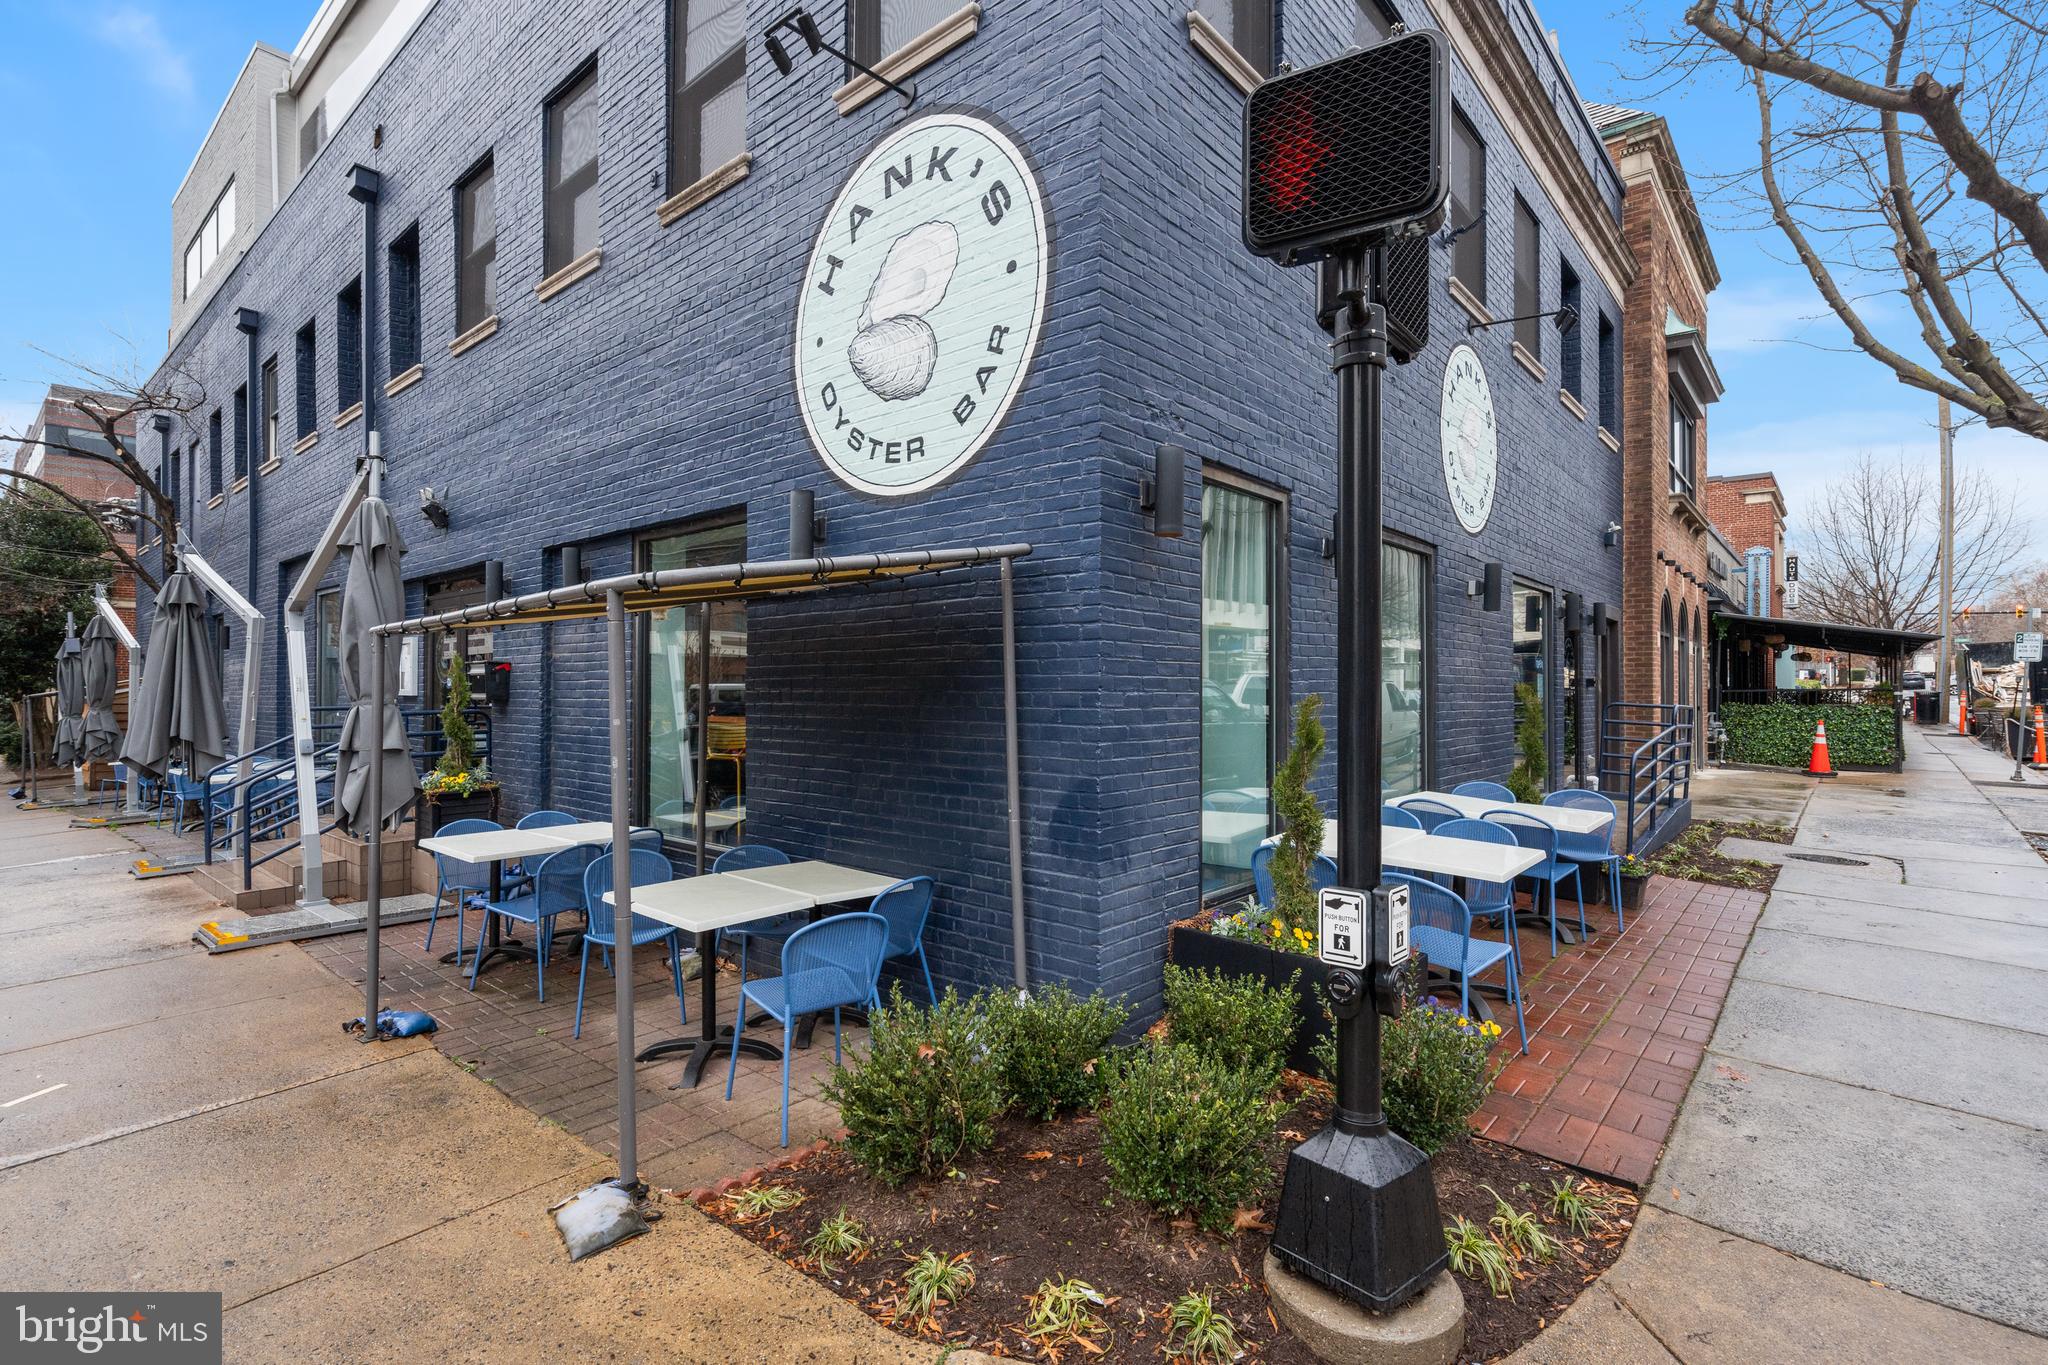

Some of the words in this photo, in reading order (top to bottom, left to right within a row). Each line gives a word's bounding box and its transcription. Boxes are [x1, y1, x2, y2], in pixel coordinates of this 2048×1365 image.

[817, 146, 1012, 296] HANK'S
[821, 382, 925, 464] OYSTER
[952, 324, 1010, 427] BAR
[2017, 634, 2023, 642] 2
[1324, 912, 1338, 920] PUSH
[1338, 914, 1358, 923] BUTTON
[1334, 923, 1350, 933] FOR
